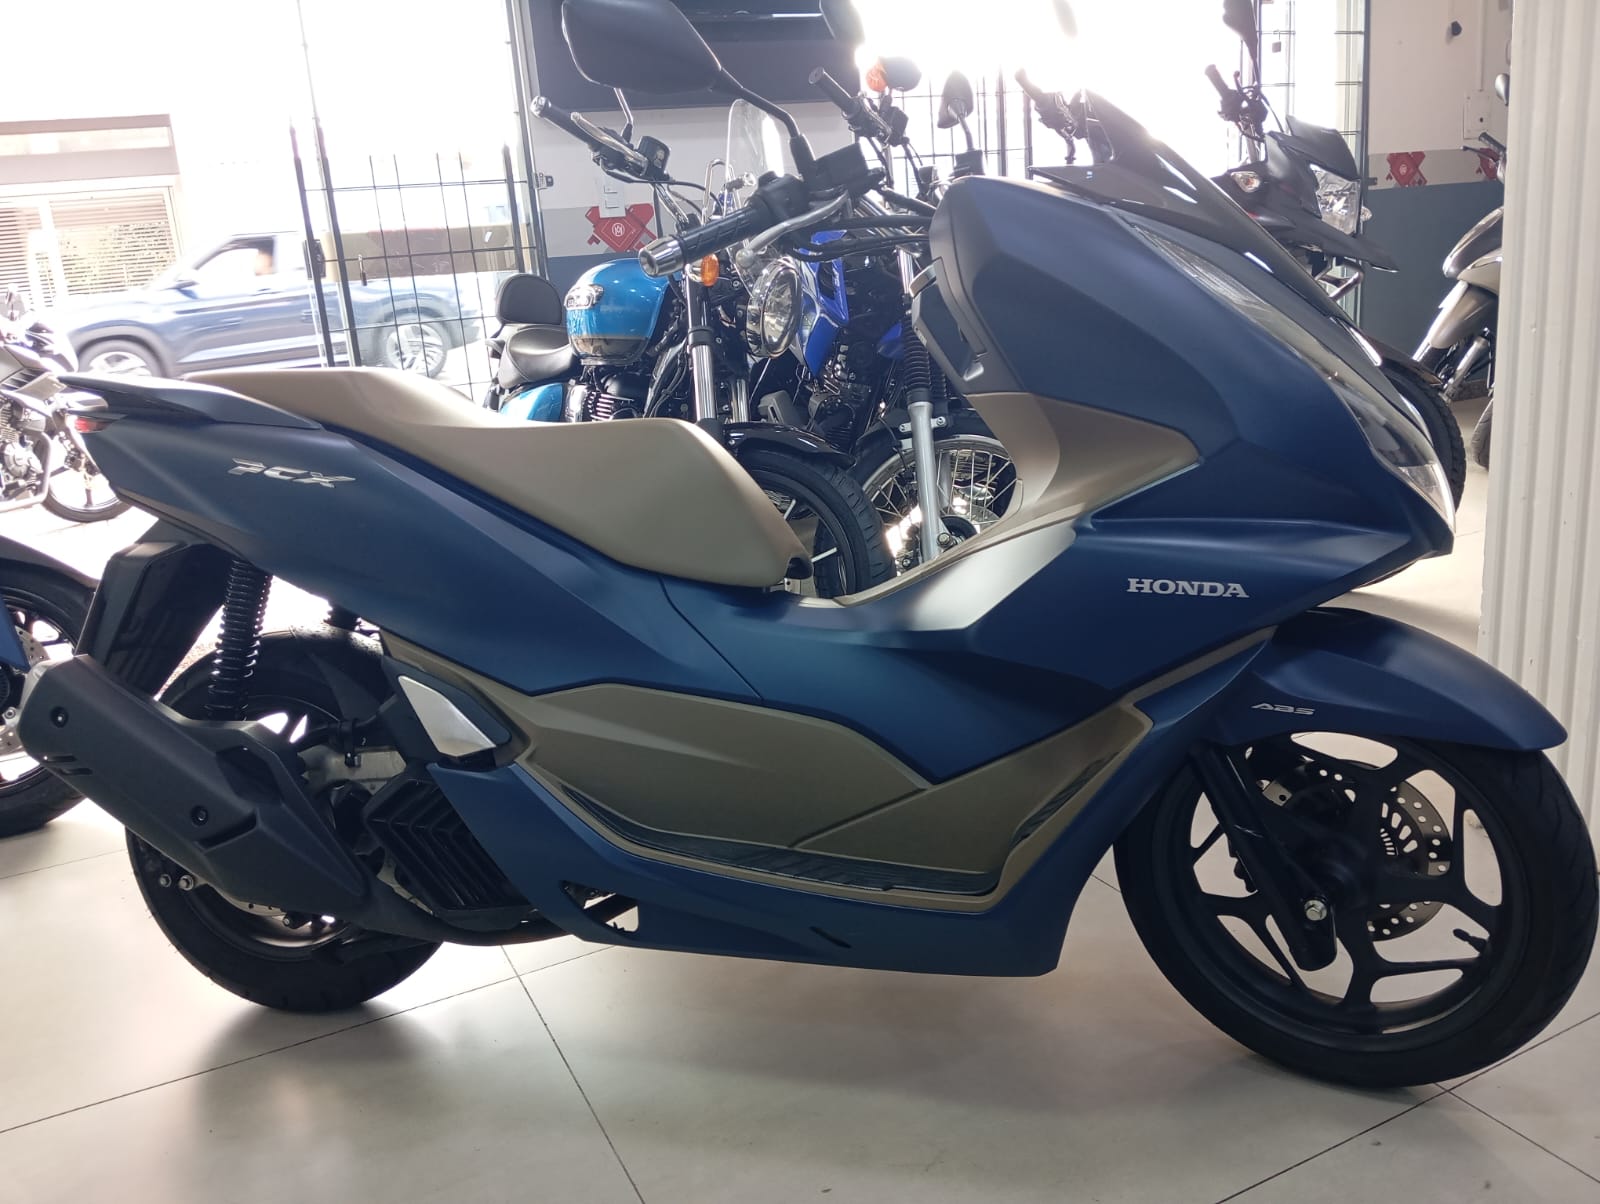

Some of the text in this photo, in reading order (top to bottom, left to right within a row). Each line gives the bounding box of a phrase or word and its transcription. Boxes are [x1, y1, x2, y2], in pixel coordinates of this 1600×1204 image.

[227, 457, 356, 488] PCX
[1126, 577, 1250, 598] HONDA
[1250, 702, 1315, 715] ABS
